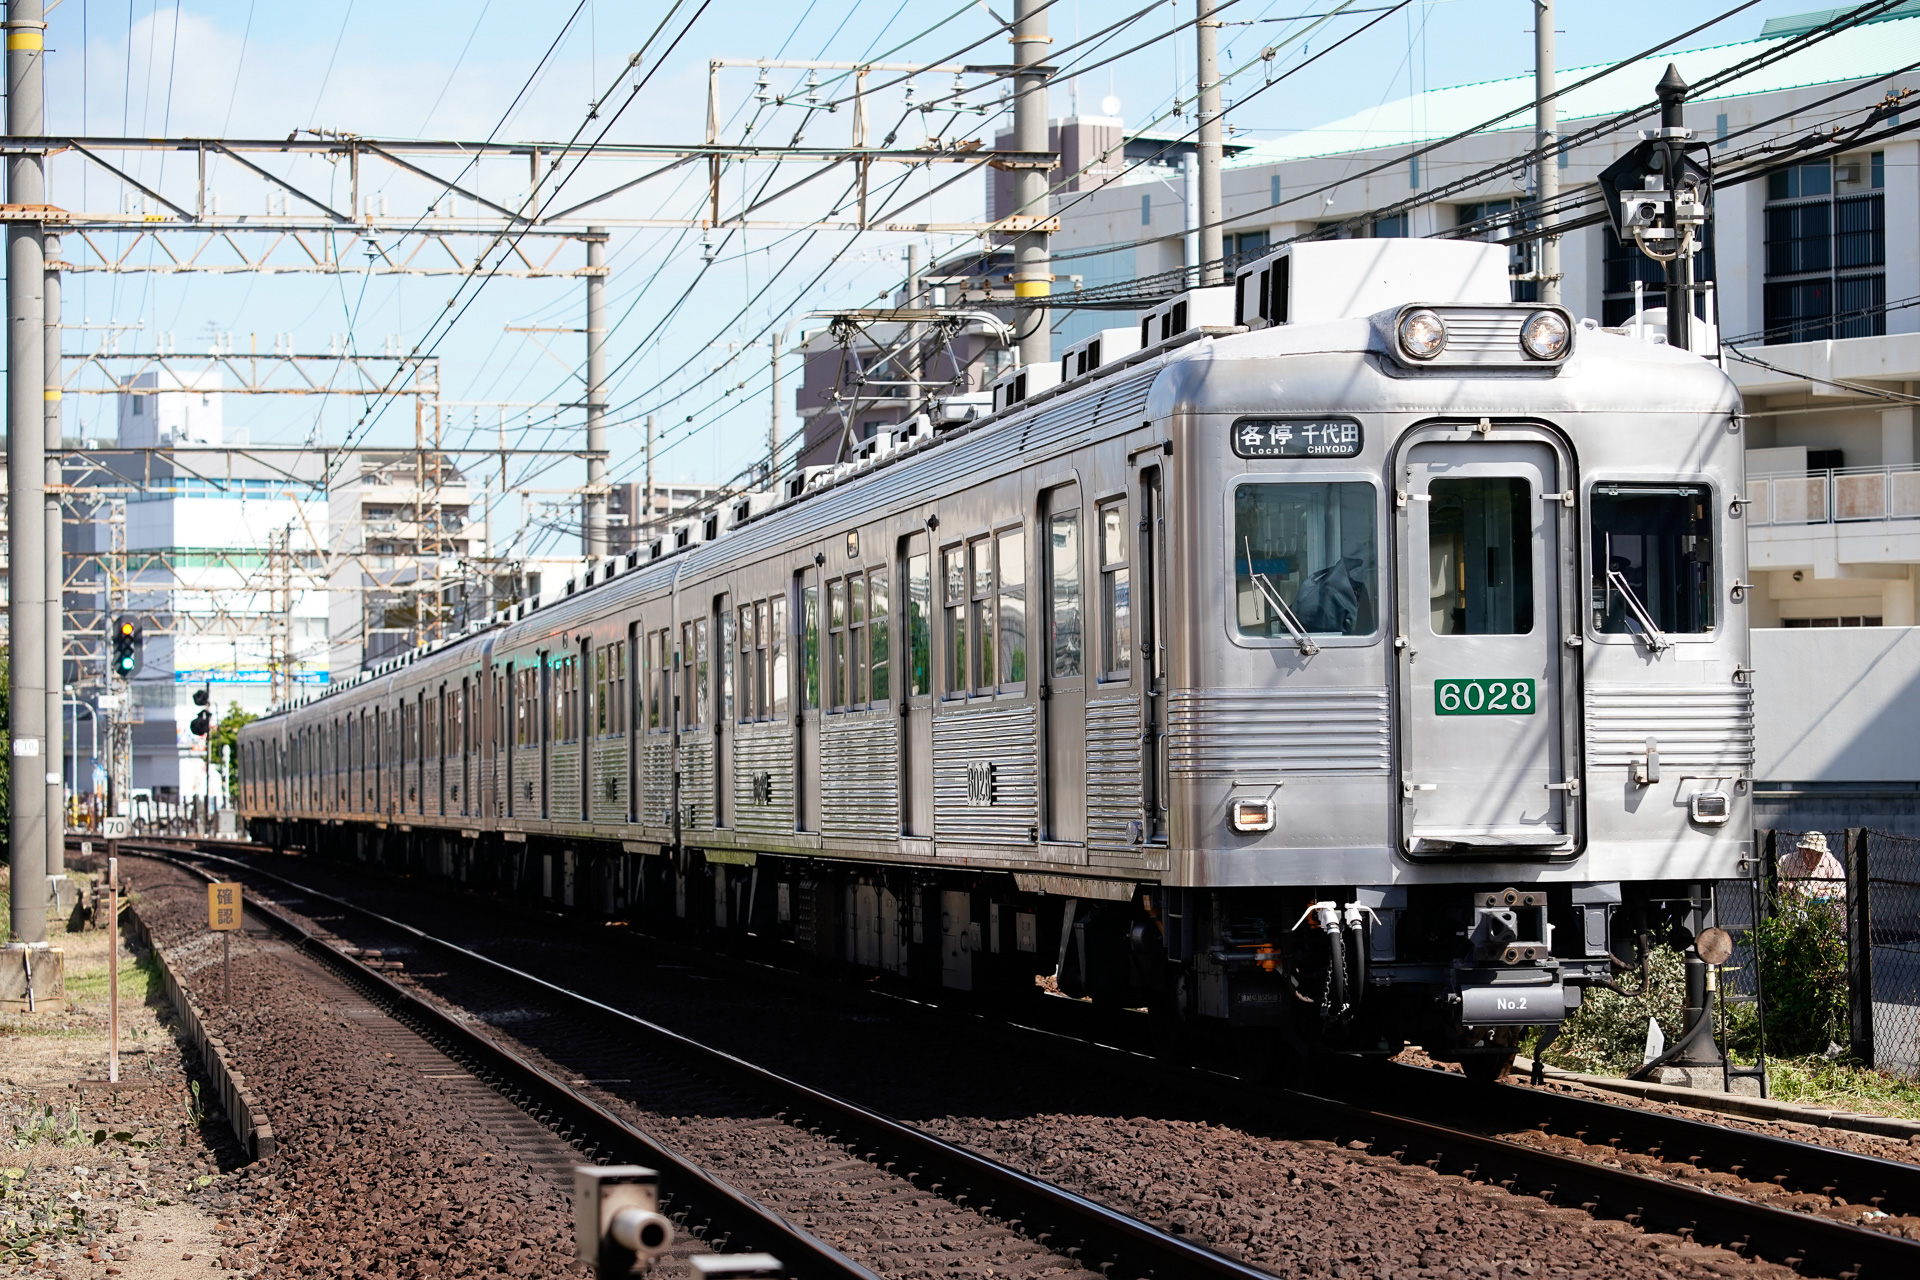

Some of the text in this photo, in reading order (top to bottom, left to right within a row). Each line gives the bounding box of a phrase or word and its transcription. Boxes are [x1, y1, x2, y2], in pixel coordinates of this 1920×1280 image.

[1240, 423, 1358, 446] 各停 千代田
[1250, 447, 1284, 455] Local
[1307, 445, 1354, 454] CHIYODA
[1439, 682, 1532, 711] 6028
[968, 767, 991, 802] 6028
[106, 821, 124, 834] 70
[216, 888, 234, 925] 確認
[1497, 997, 1527, 1010] No.2
